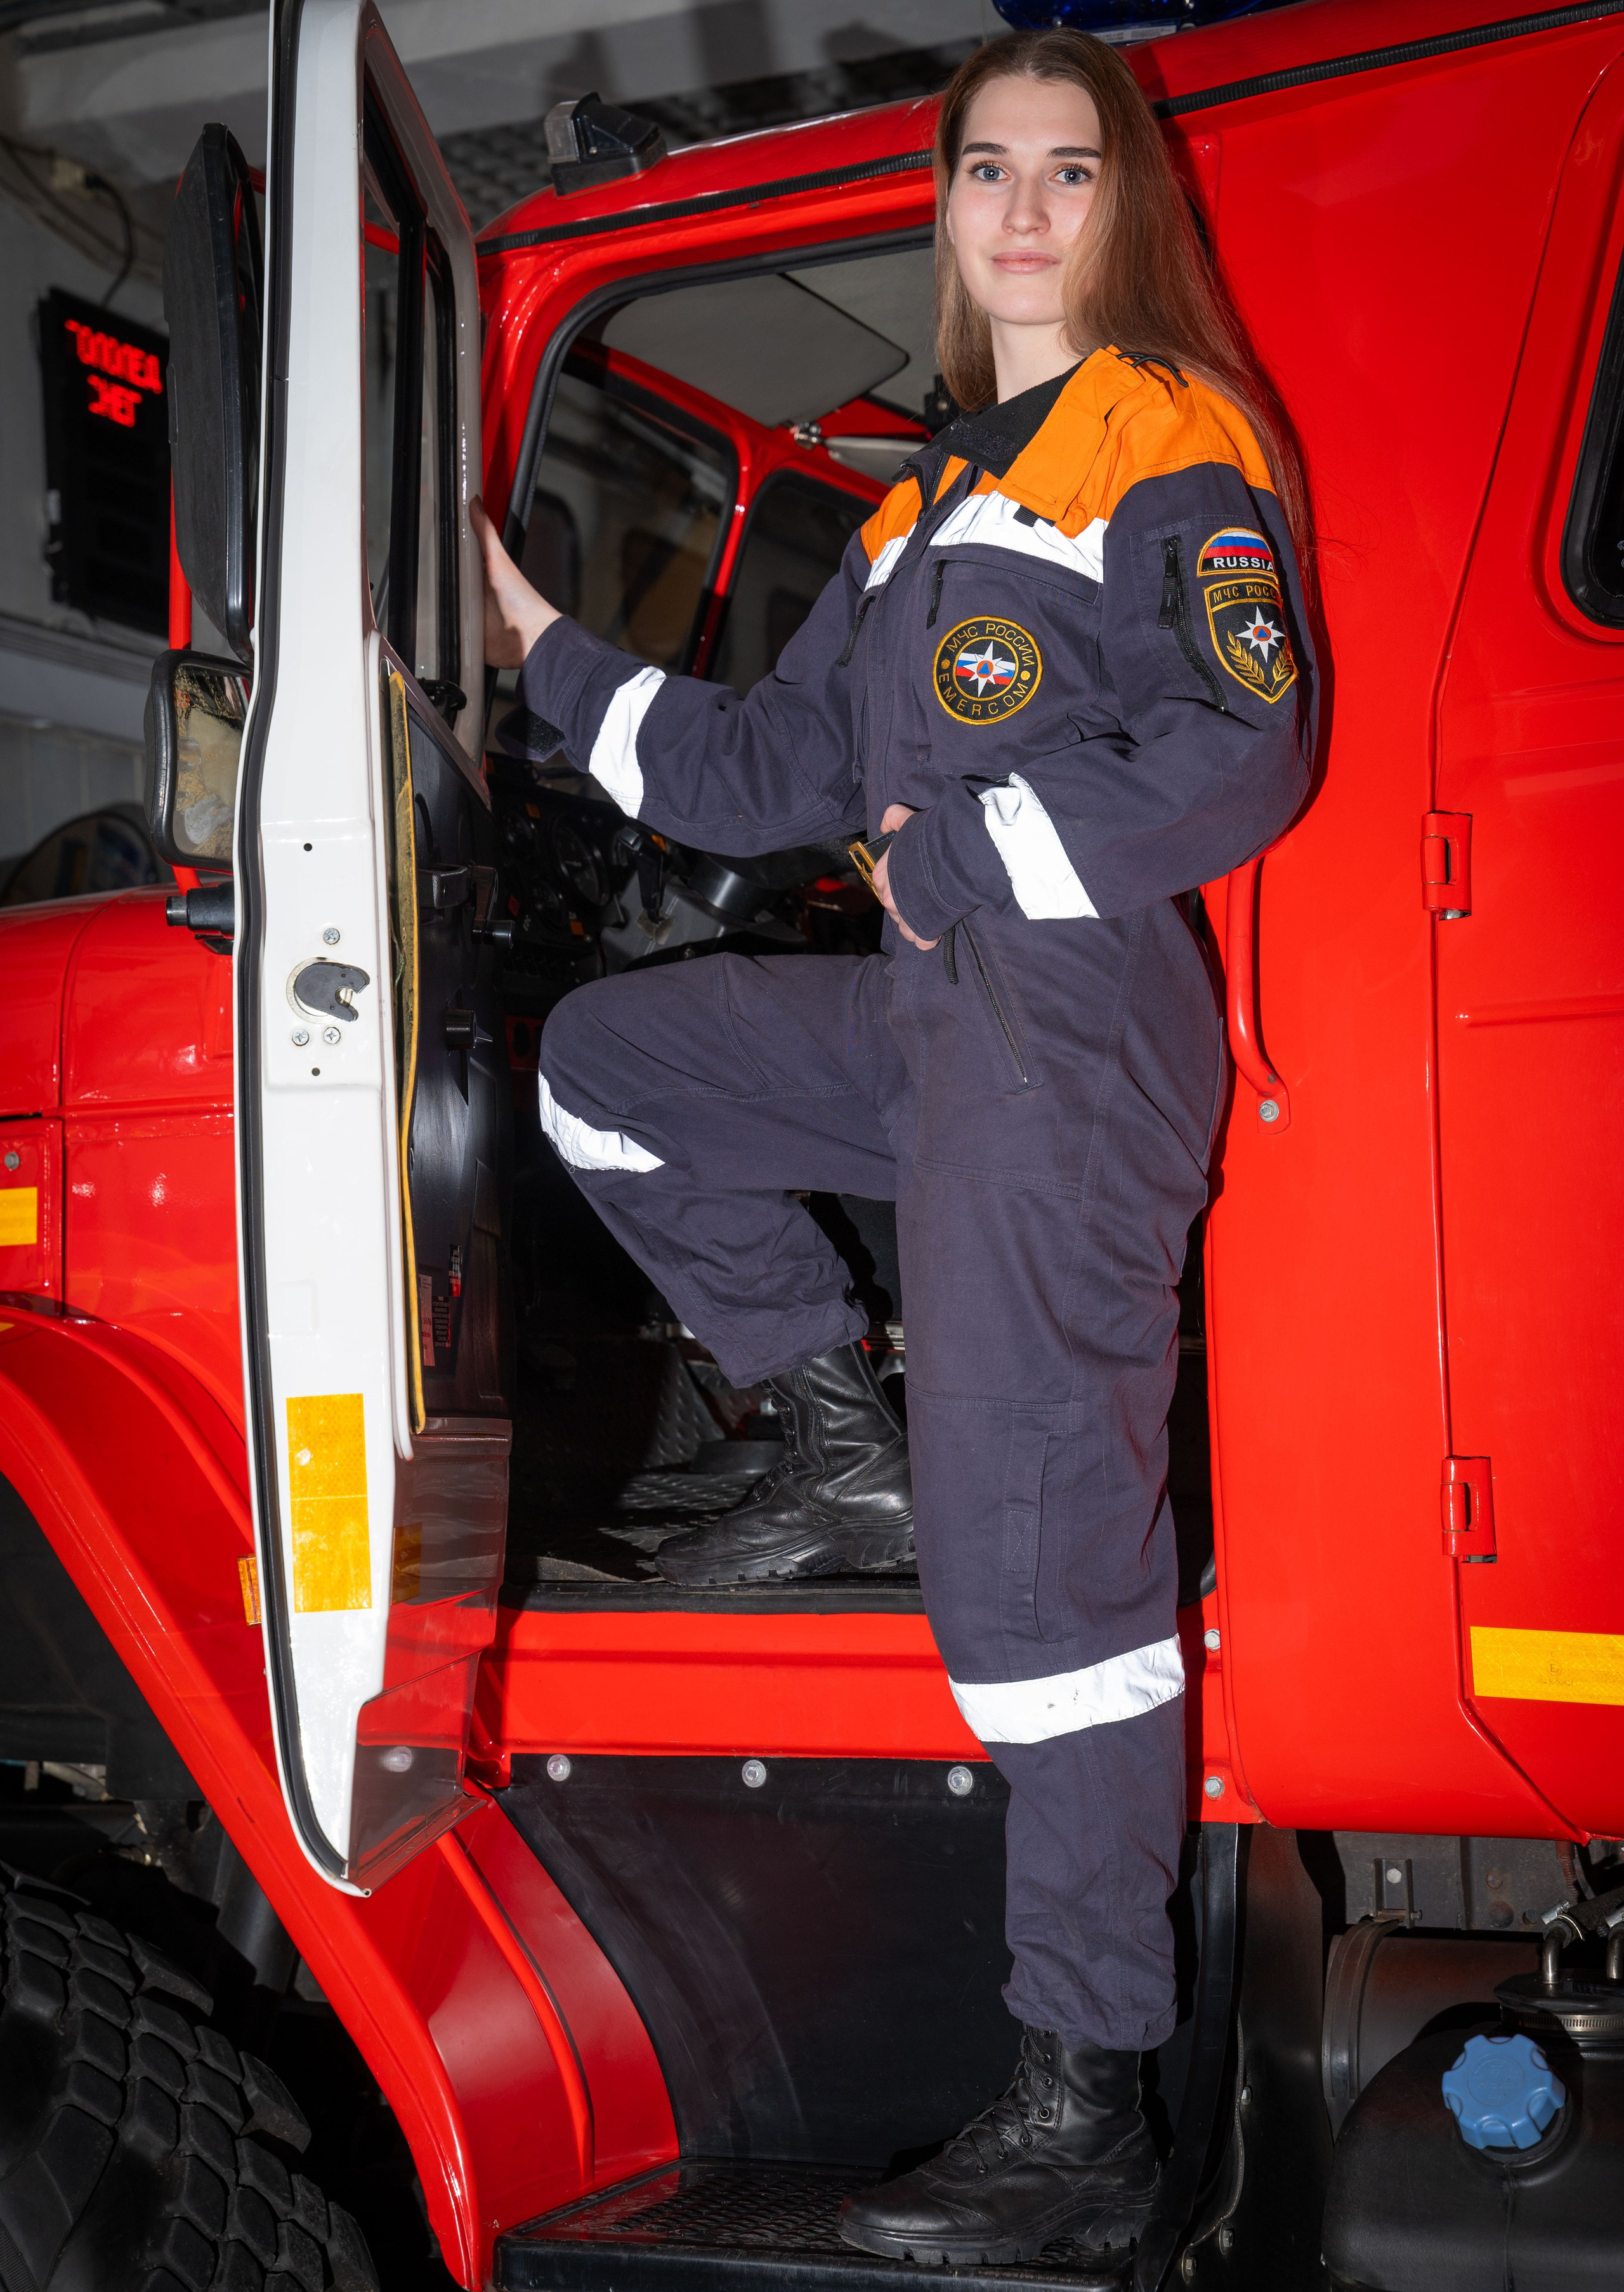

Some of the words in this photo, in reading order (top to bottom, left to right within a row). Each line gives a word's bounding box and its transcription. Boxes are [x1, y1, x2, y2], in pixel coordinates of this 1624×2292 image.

[1213, 556, 1274, 572] RUSSIA
[1212, 586, 1240, 603] МЧС
[1246, 585, 1278, 599] РОСС
[946, 626, 978, 652] МЧС
[985, 622, 1035, 666] РОССИИ
[938, 673, 1029, 716] EMERCOM
